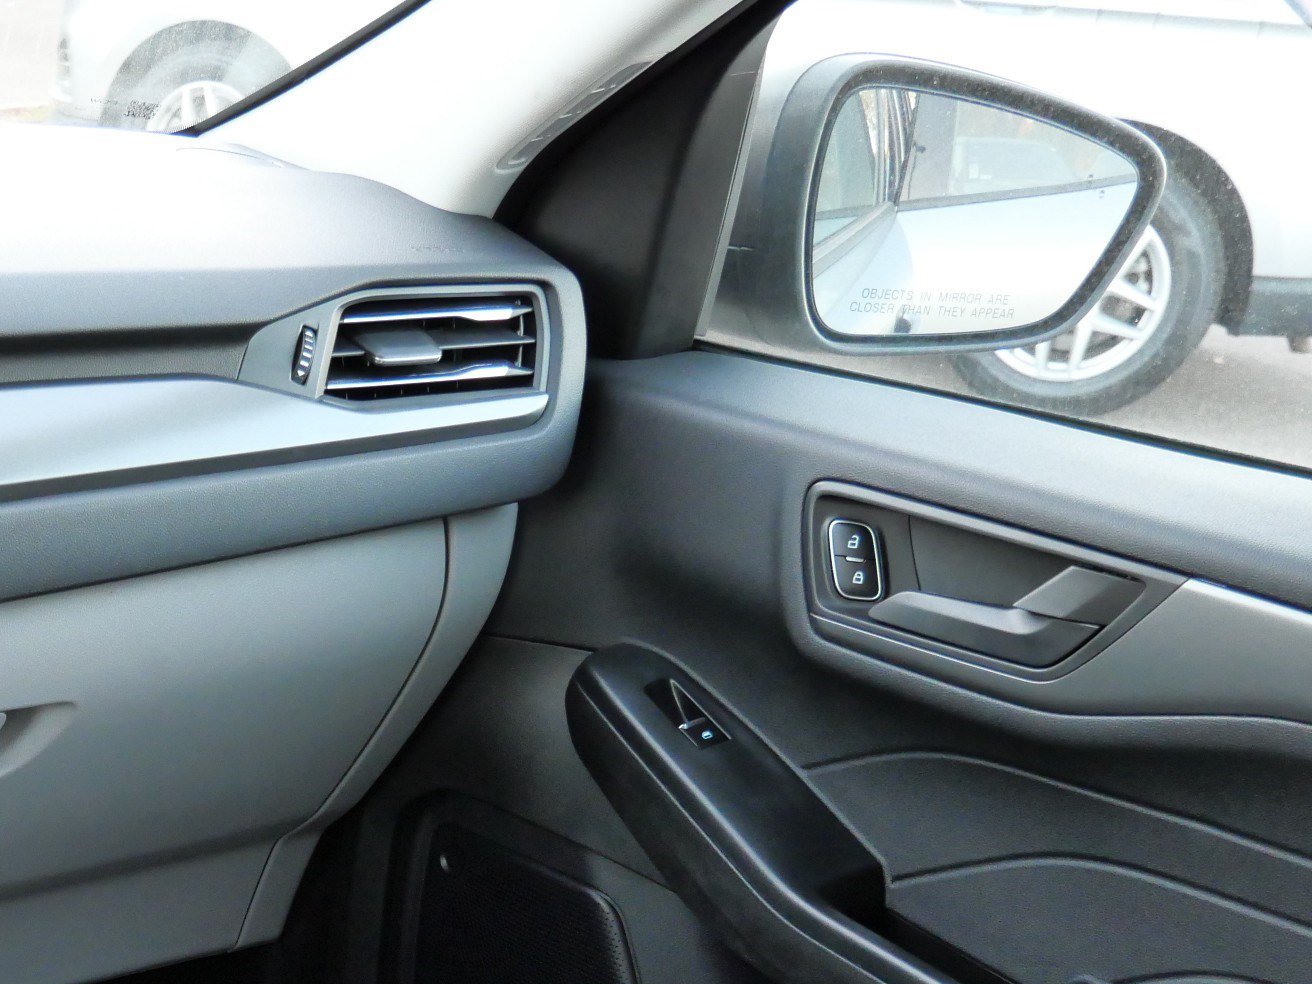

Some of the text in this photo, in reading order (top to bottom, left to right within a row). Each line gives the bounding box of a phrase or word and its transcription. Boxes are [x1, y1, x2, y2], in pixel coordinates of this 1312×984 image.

[861, 287, 1011, 305] OBJECTS IN MIRROR ARE
[849, 301, 1015, 319] CLOSER THAN THEY APPEAR
